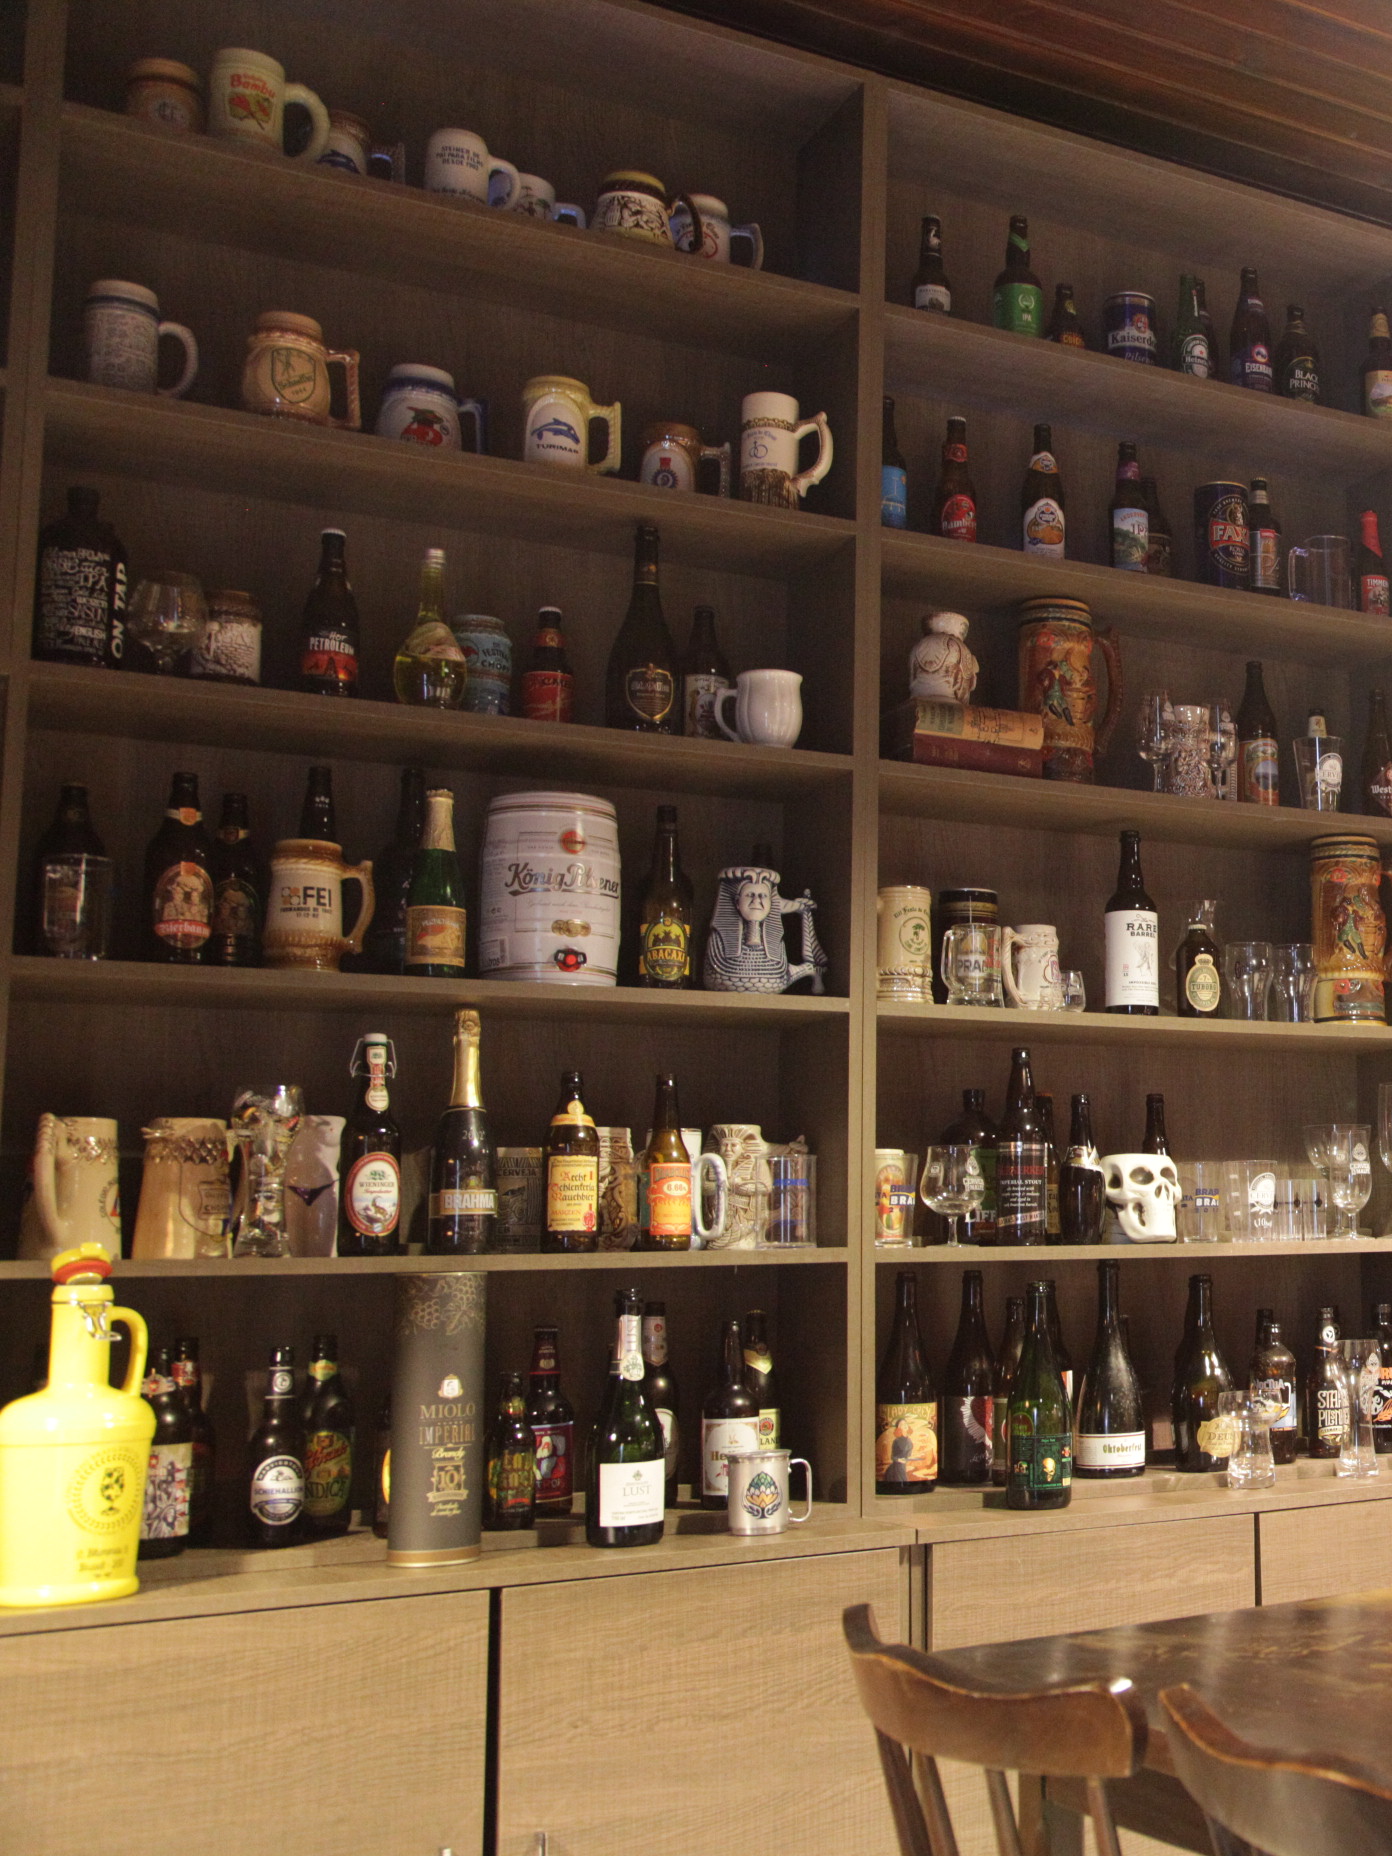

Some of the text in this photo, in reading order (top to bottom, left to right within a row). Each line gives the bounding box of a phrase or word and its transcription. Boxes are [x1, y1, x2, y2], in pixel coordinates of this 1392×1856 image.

[230, 74, 275, 99] Bambu
[535, 444, 578, 454] TURIMAR
[112, 562, 127, 659] ON TAP
[303, 887, 332, 908] FEI
[1126, 922, 1157, 934] RARE
[444, 1193, 494, 1209] BRAHMA
[420, 1404, 476, 1419] MIOLO
[419, 1424, 476, 1445] IMPERIAL
[438, 1472, 458, 1489] 10
[623, 1485, 651, 1498] LUST
